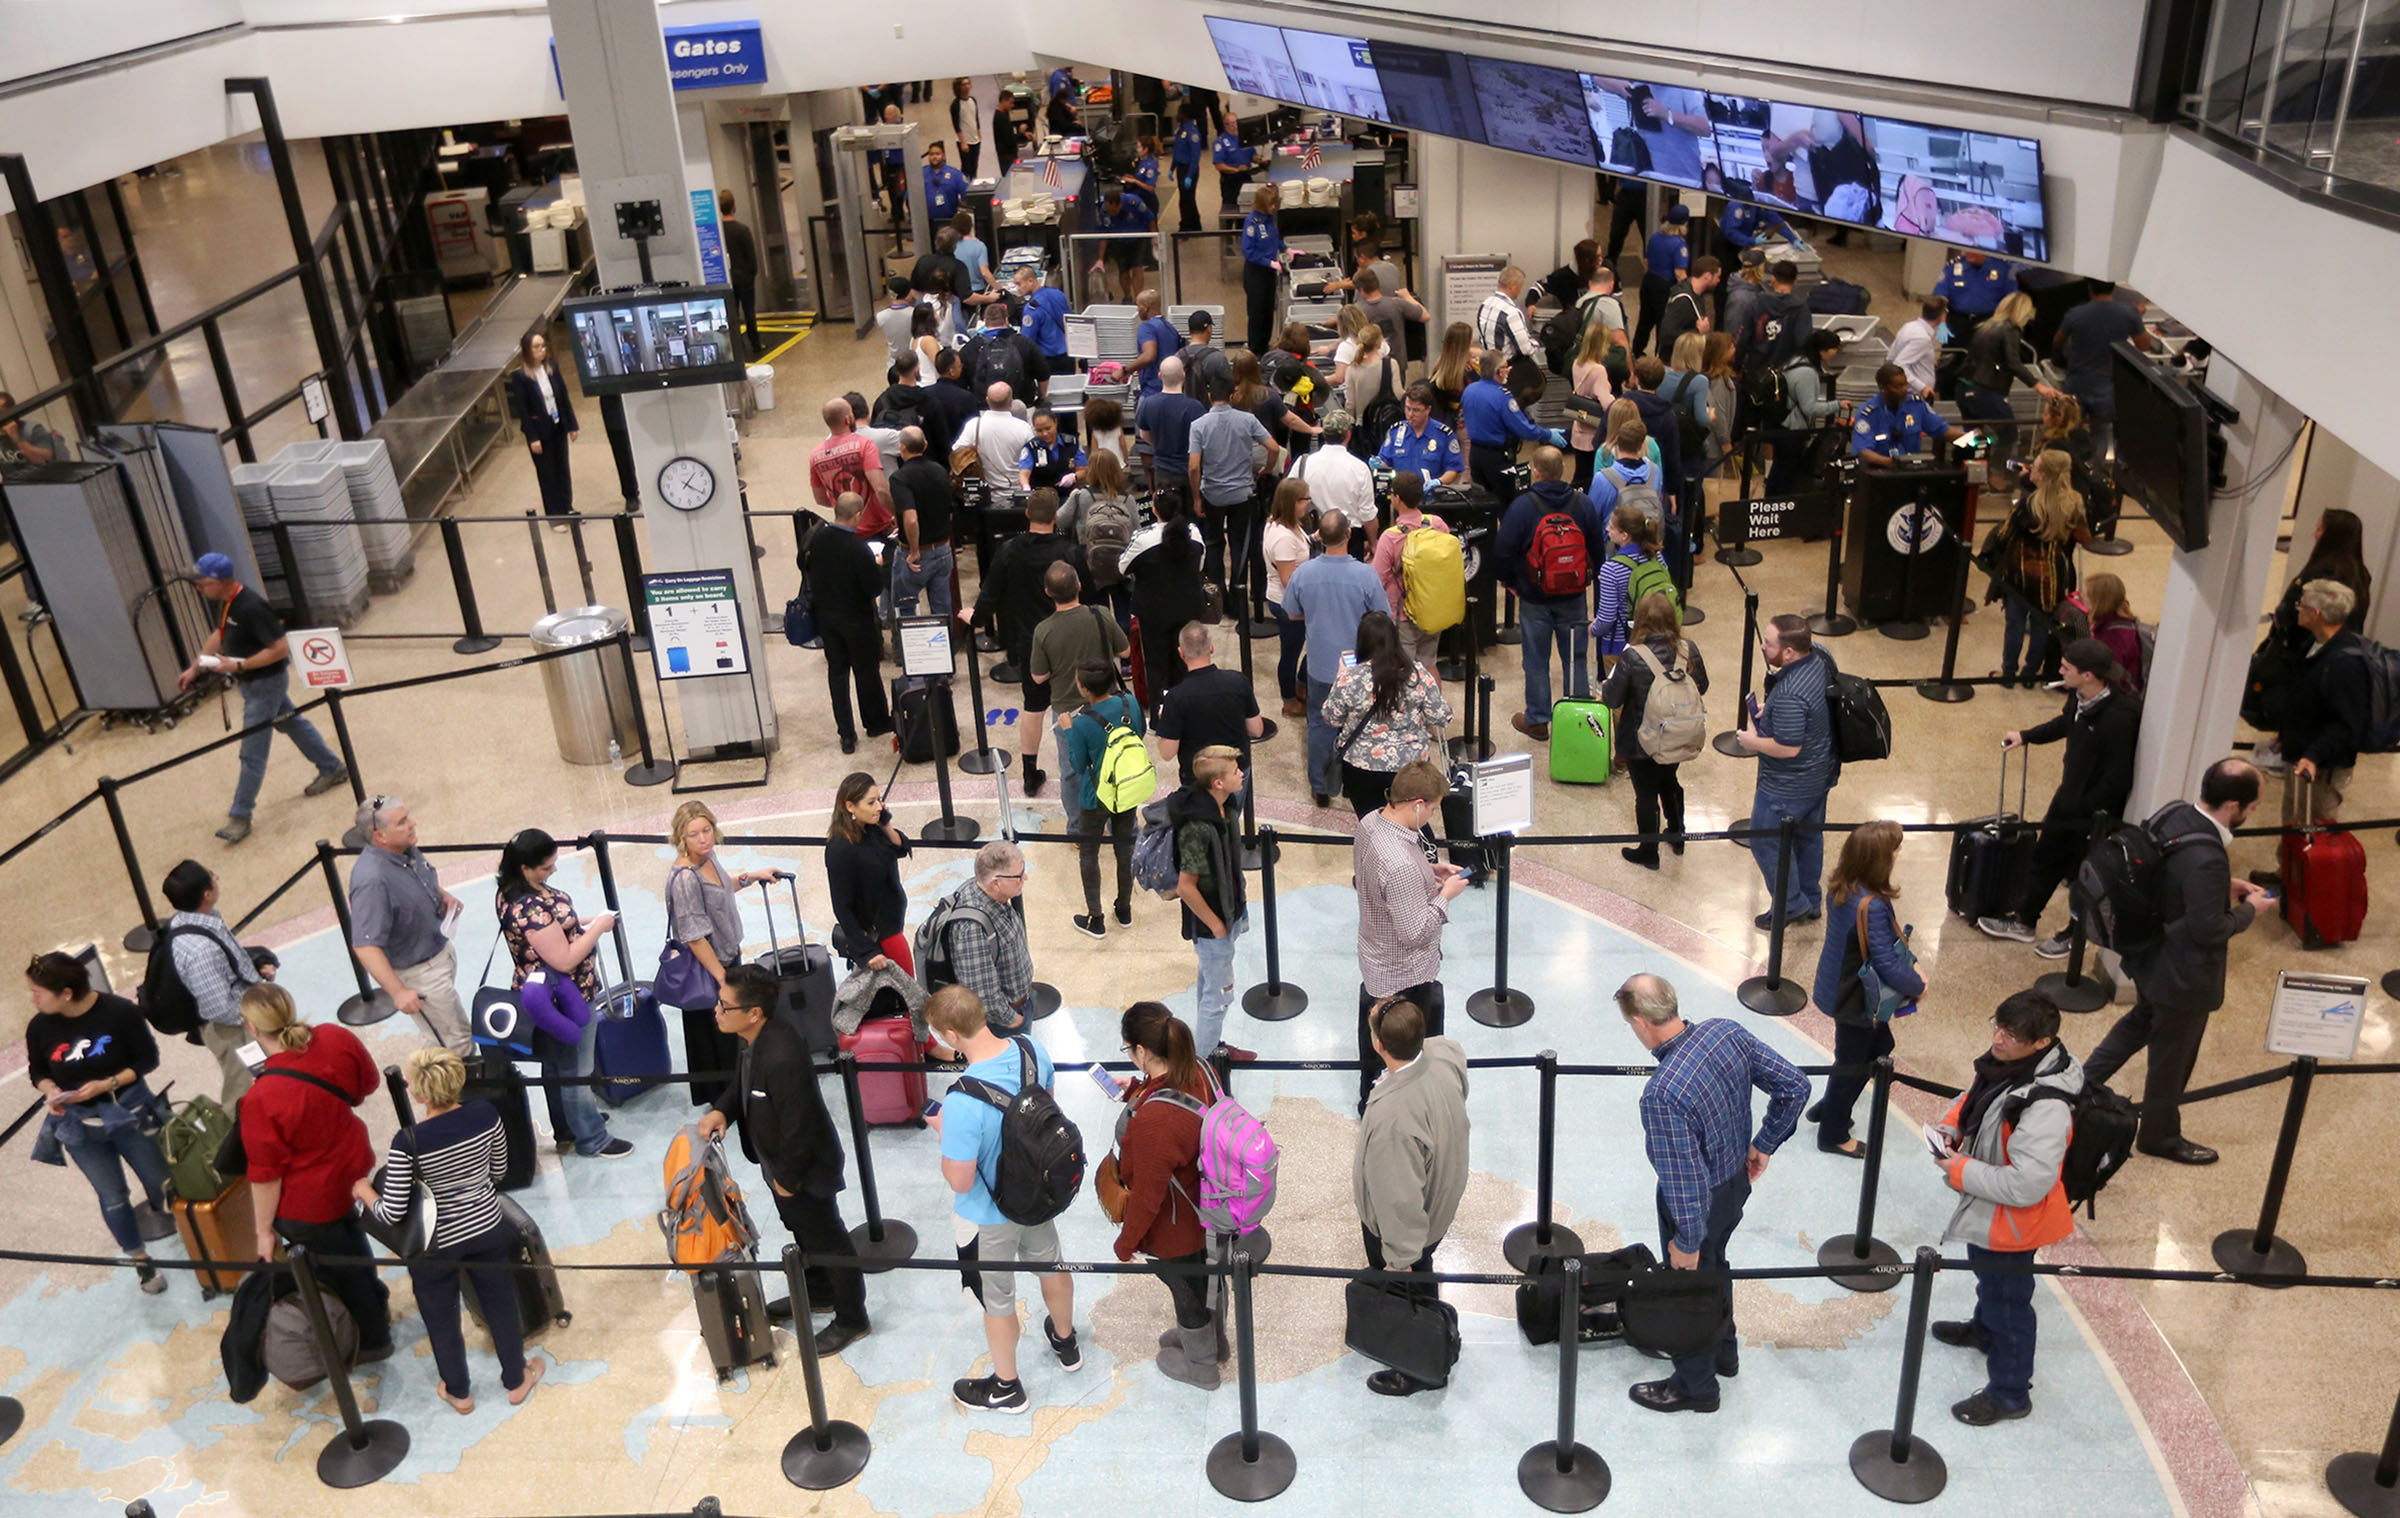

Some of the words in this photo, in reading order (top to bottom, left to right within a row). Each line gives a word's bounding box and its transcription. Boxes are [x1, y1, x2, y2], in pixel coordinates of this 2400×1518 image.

[673, 40, 741, 58] Gates
[723, 63, 749, 76] Only
[1750, 501, 1795, 513] Please
[1749, 513, 1779, 526] Wait
[1749, 527, 1780, 538] Here
[665, 606, 673, 617] 1
[711, 603, 718, 613] 1
[1054, 1262, 1095, 1272] AIRPORTS
[1873, 1264, 1915, 1275] AIRPORTS
